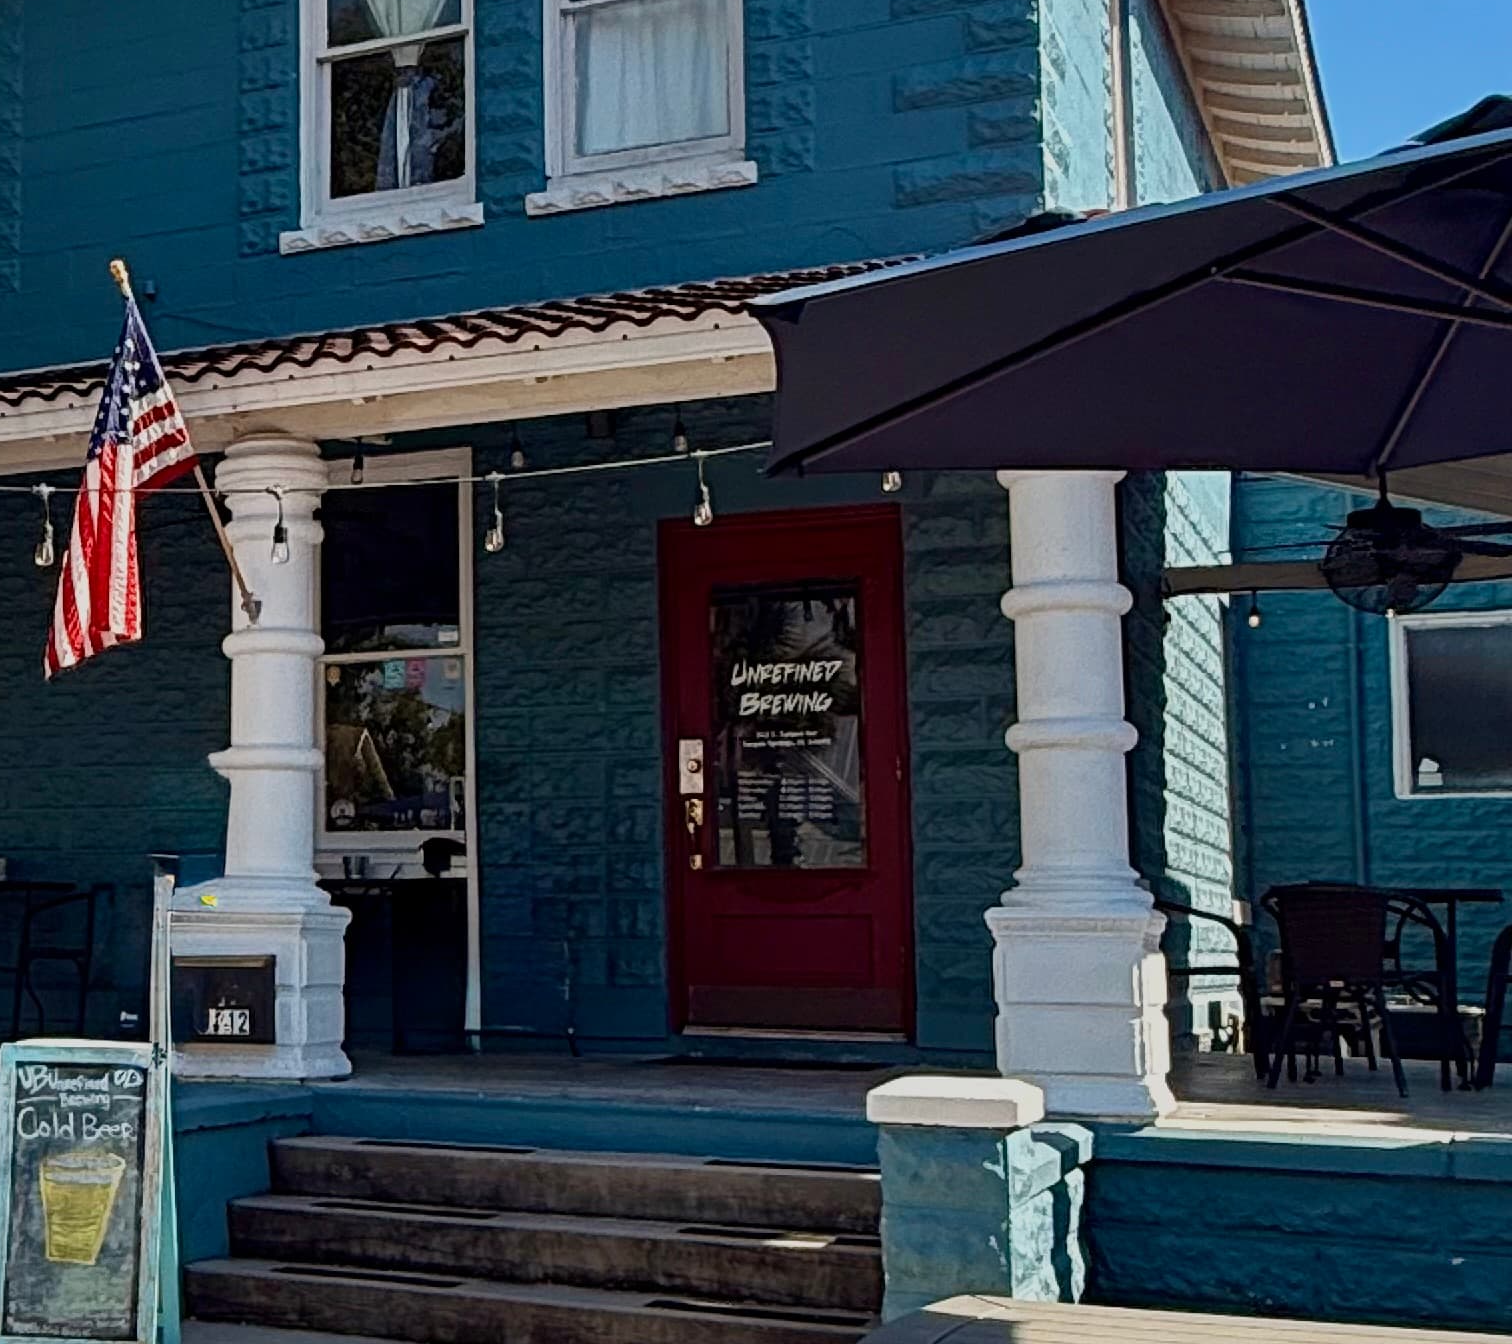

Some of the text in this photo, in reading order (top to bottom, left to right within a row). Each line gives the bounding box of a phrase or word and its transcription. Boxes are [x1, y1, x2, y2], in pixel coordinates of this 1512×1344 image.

[731, 657, 843, 686] UNREFINED
[739, 691, 833, 716] BREWING
[17, 1106, 74, 1140] Cold
